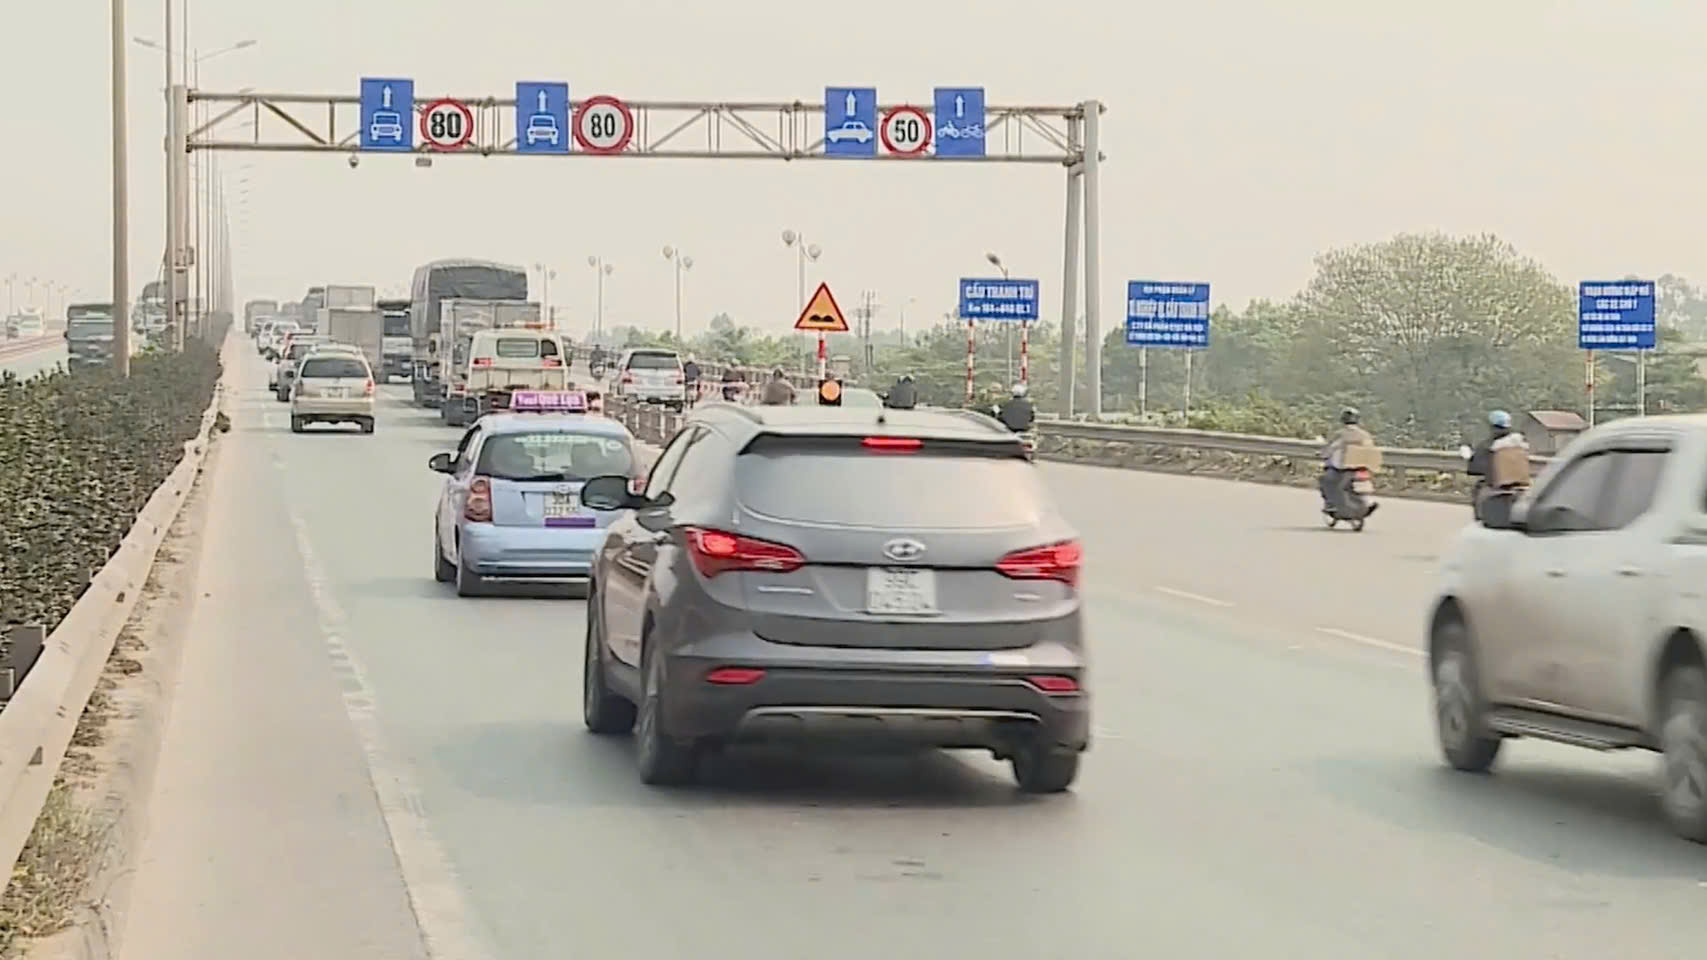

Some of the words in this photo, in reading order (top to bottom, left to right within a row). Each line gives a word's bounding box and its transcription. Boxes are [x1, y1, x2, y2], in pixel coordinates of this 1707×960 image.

[431, 112, 461, 138] 80
[590, 113, 615, 138] 80
[895, 119, 919, 142] 50
